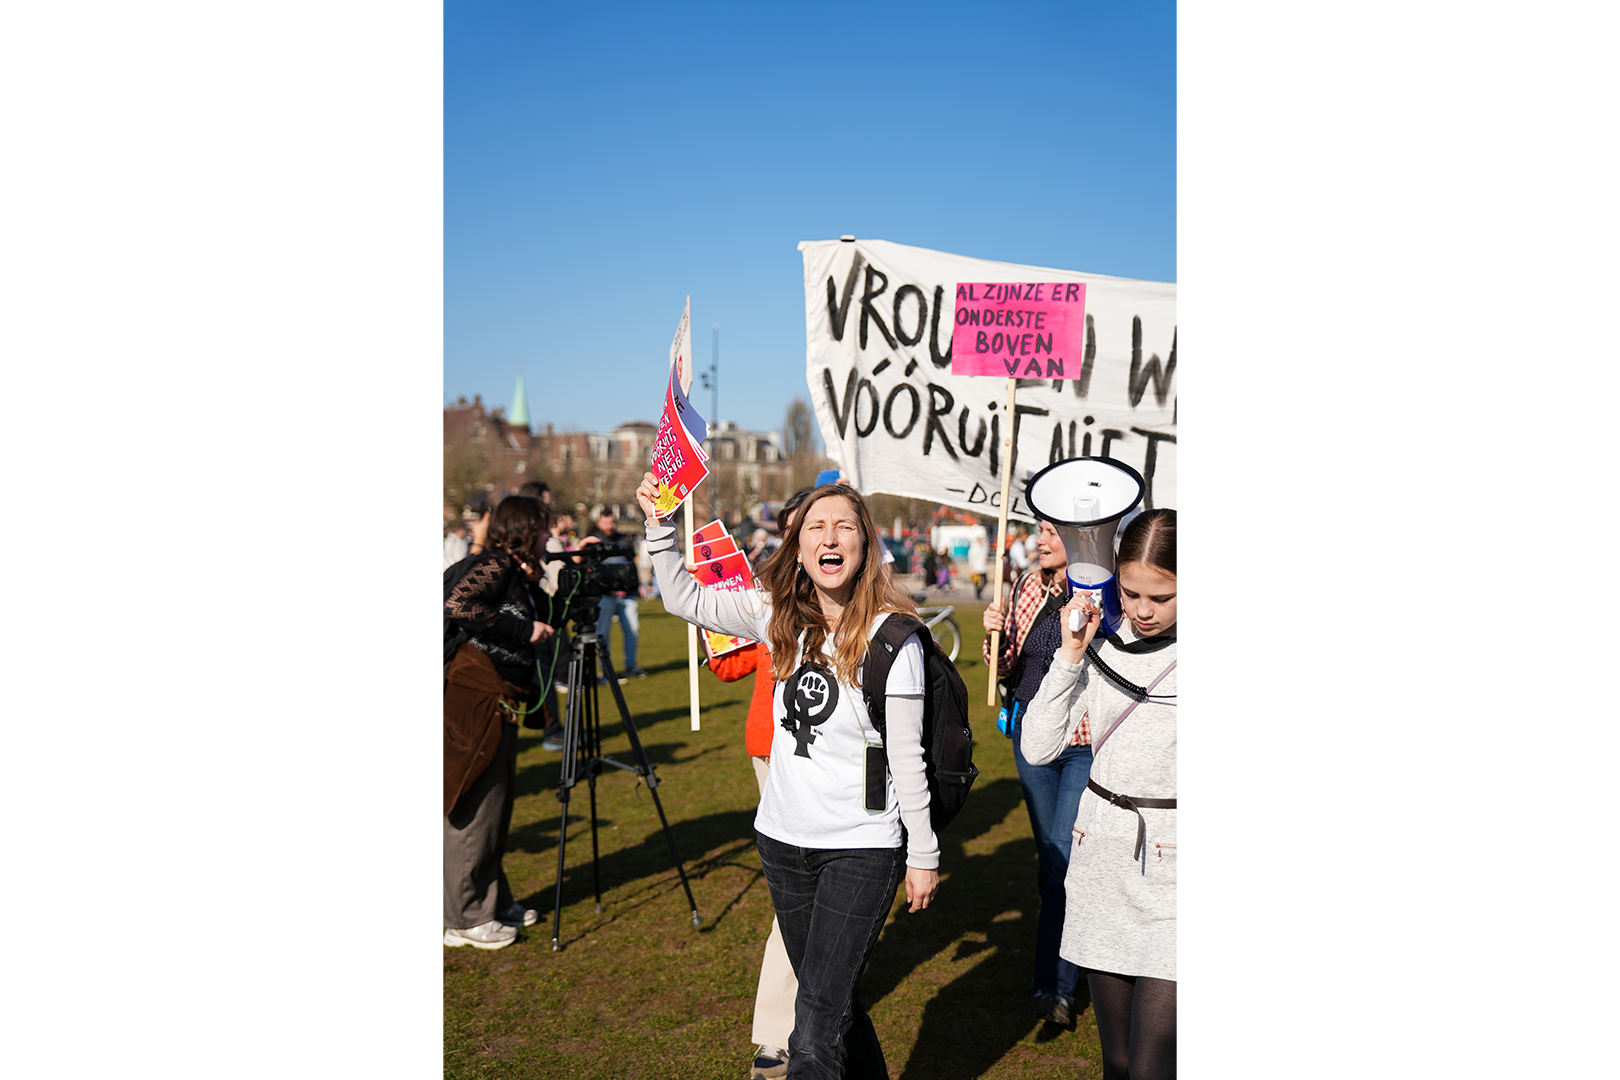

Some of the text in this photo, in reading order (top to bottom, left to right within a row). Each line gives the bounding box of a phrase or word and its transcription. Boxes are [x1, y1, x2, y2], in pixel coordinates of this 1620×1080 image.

[1051, 283, 1080, 302] ER
[956, 307, 1047, 330] ONDERSTE
[975, 330, 1053, 356] BOVEN
[1003, 357, 1064, 377] VAN
[1128, 314, 1177, 411] W
